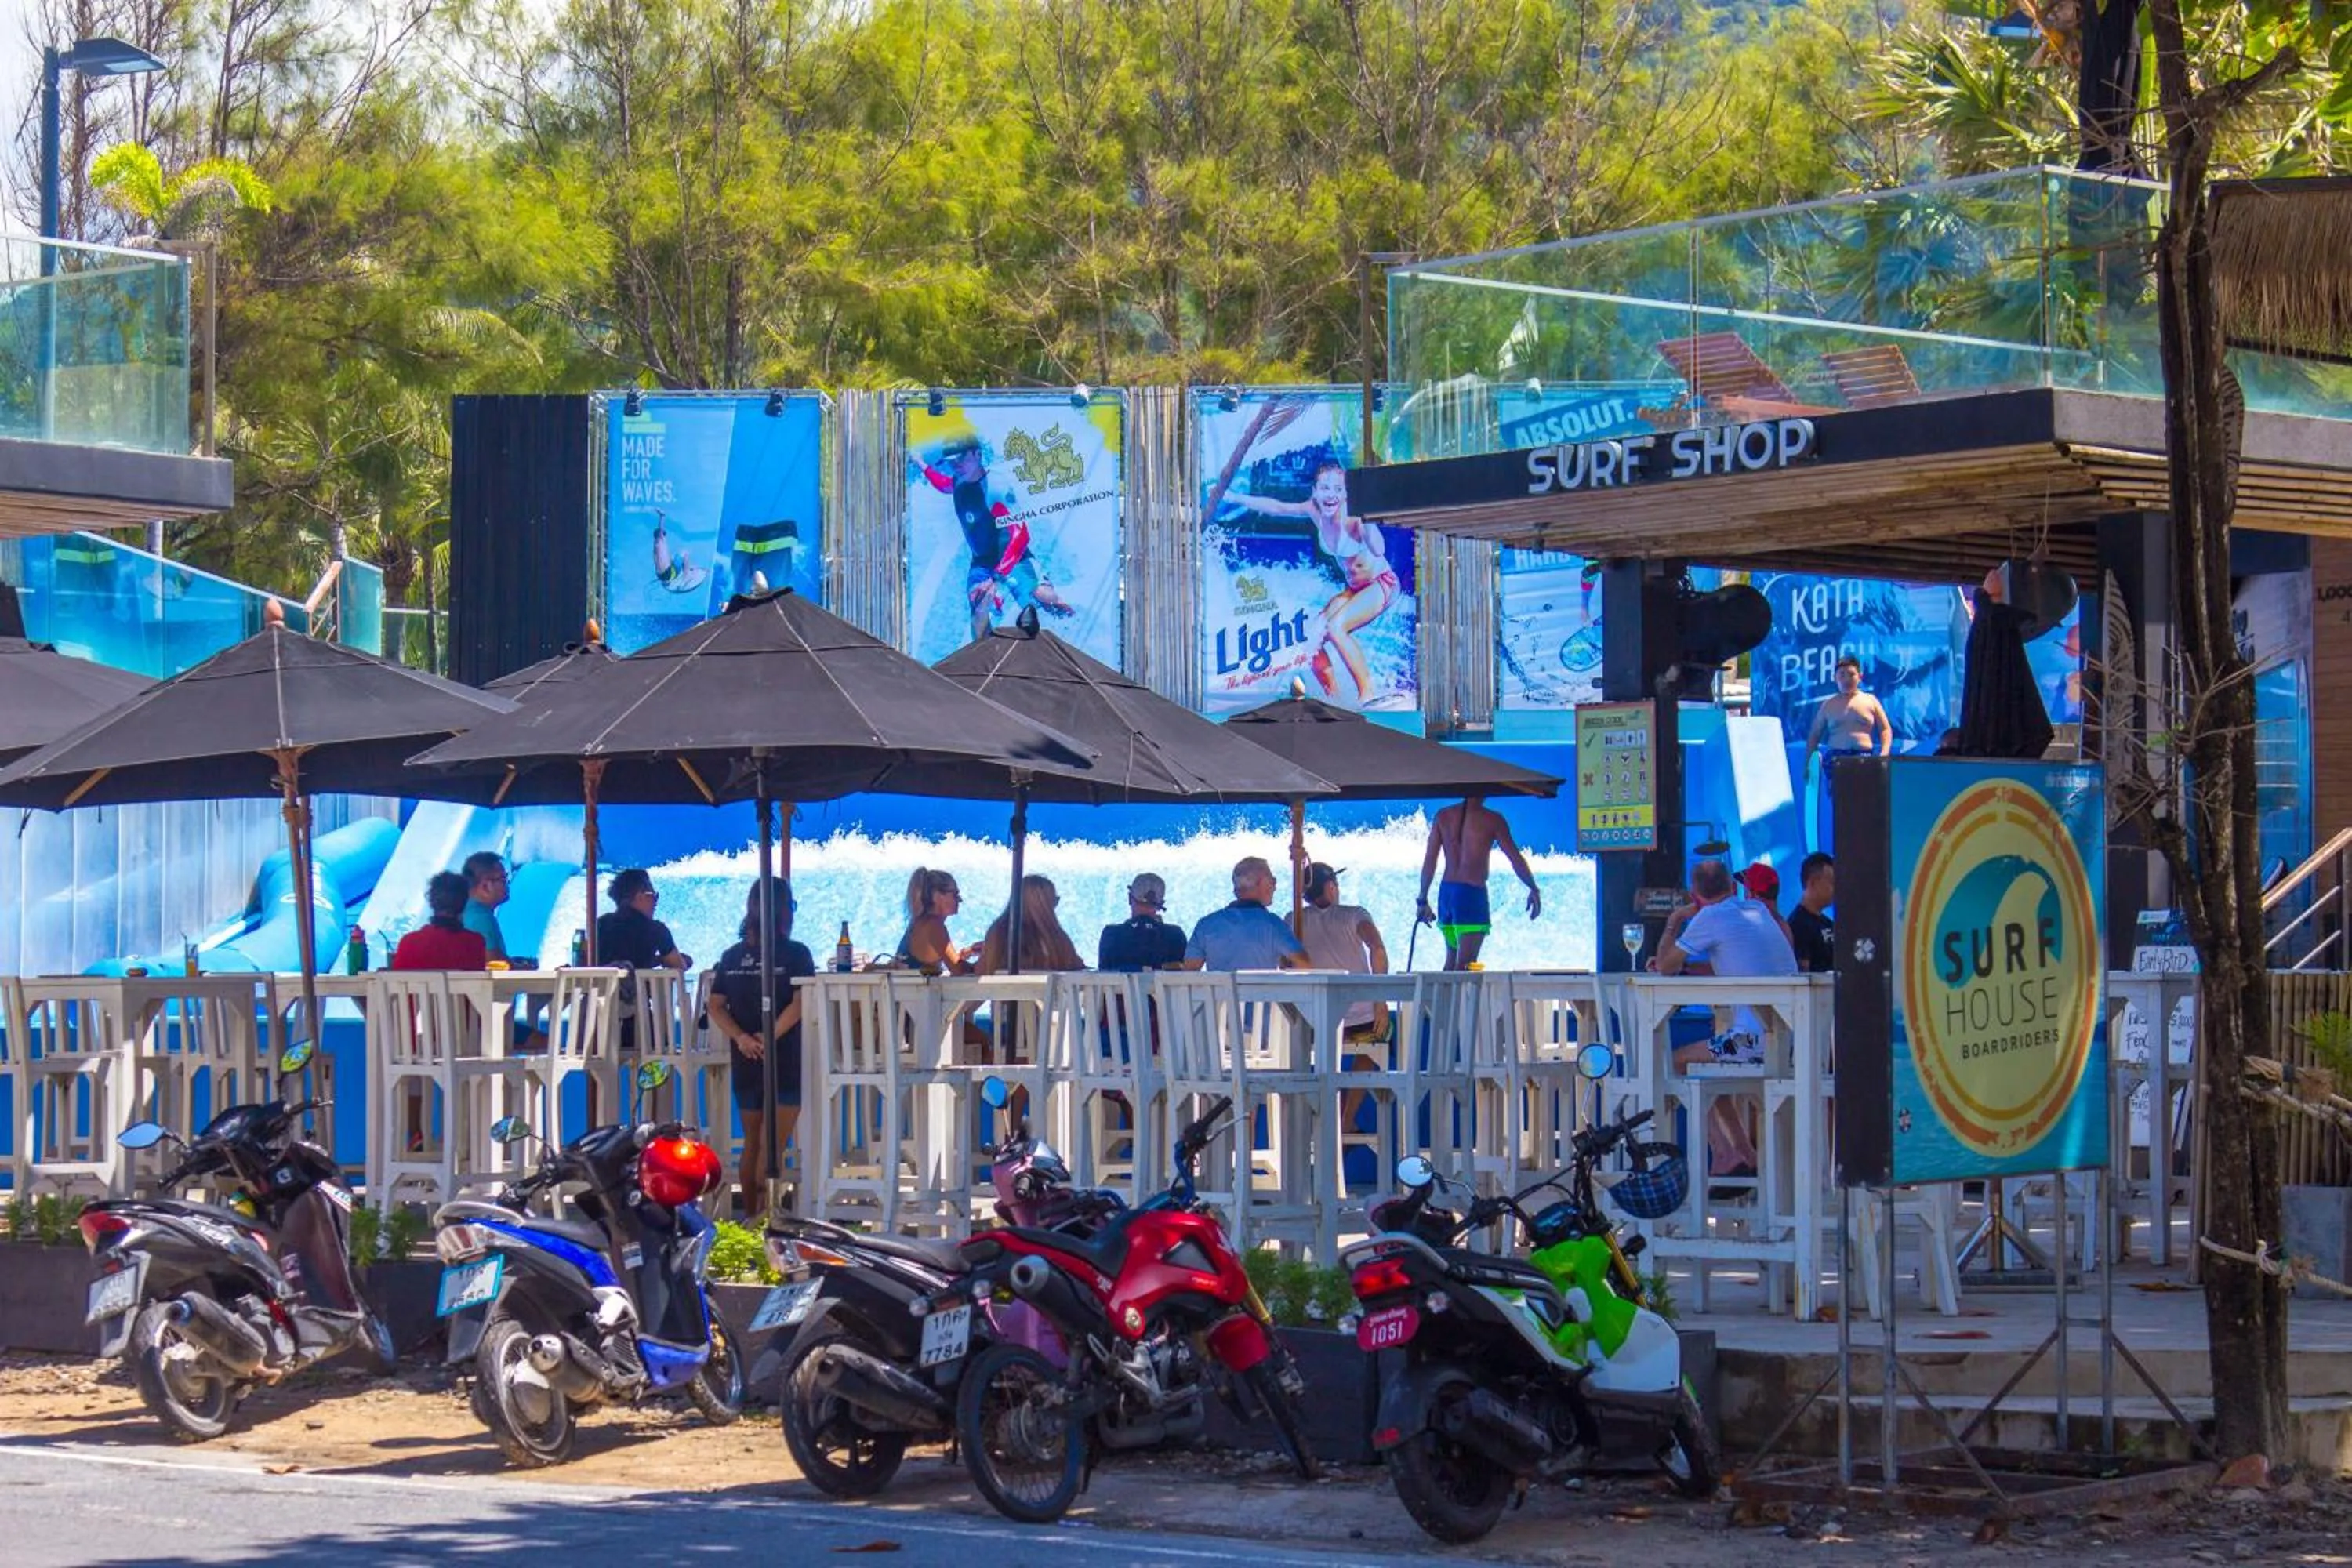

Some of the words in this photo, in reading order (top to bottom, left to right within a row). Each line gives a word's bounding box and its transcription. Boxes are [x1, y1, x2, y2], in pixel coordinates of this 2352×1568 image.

[622, 435, 666, 458] MADE
[1527, 437, 1651, 495] SURF
[1671, 419, 1811, 477] SHOP
[622, 459, 652, 480] FOR
[622, 480, 677, 503] WAVES.
[996, 508, 1037, 526] SINGHA
[1039, 489, 1115, 515] CORPORATION
[1792, 579, 1864, 633] KATA
[1216, 608, 1308, 675] Light
[1944, 917, 2055, 983] SURF
[1946, 976, 2058, 1036] HOUSE
[1962, 1028, 2060, 1059] BOARDRIDERS
[1371, 1321, 1403, 1345] 1051
[925, 1341, 963, 1363] 7784
